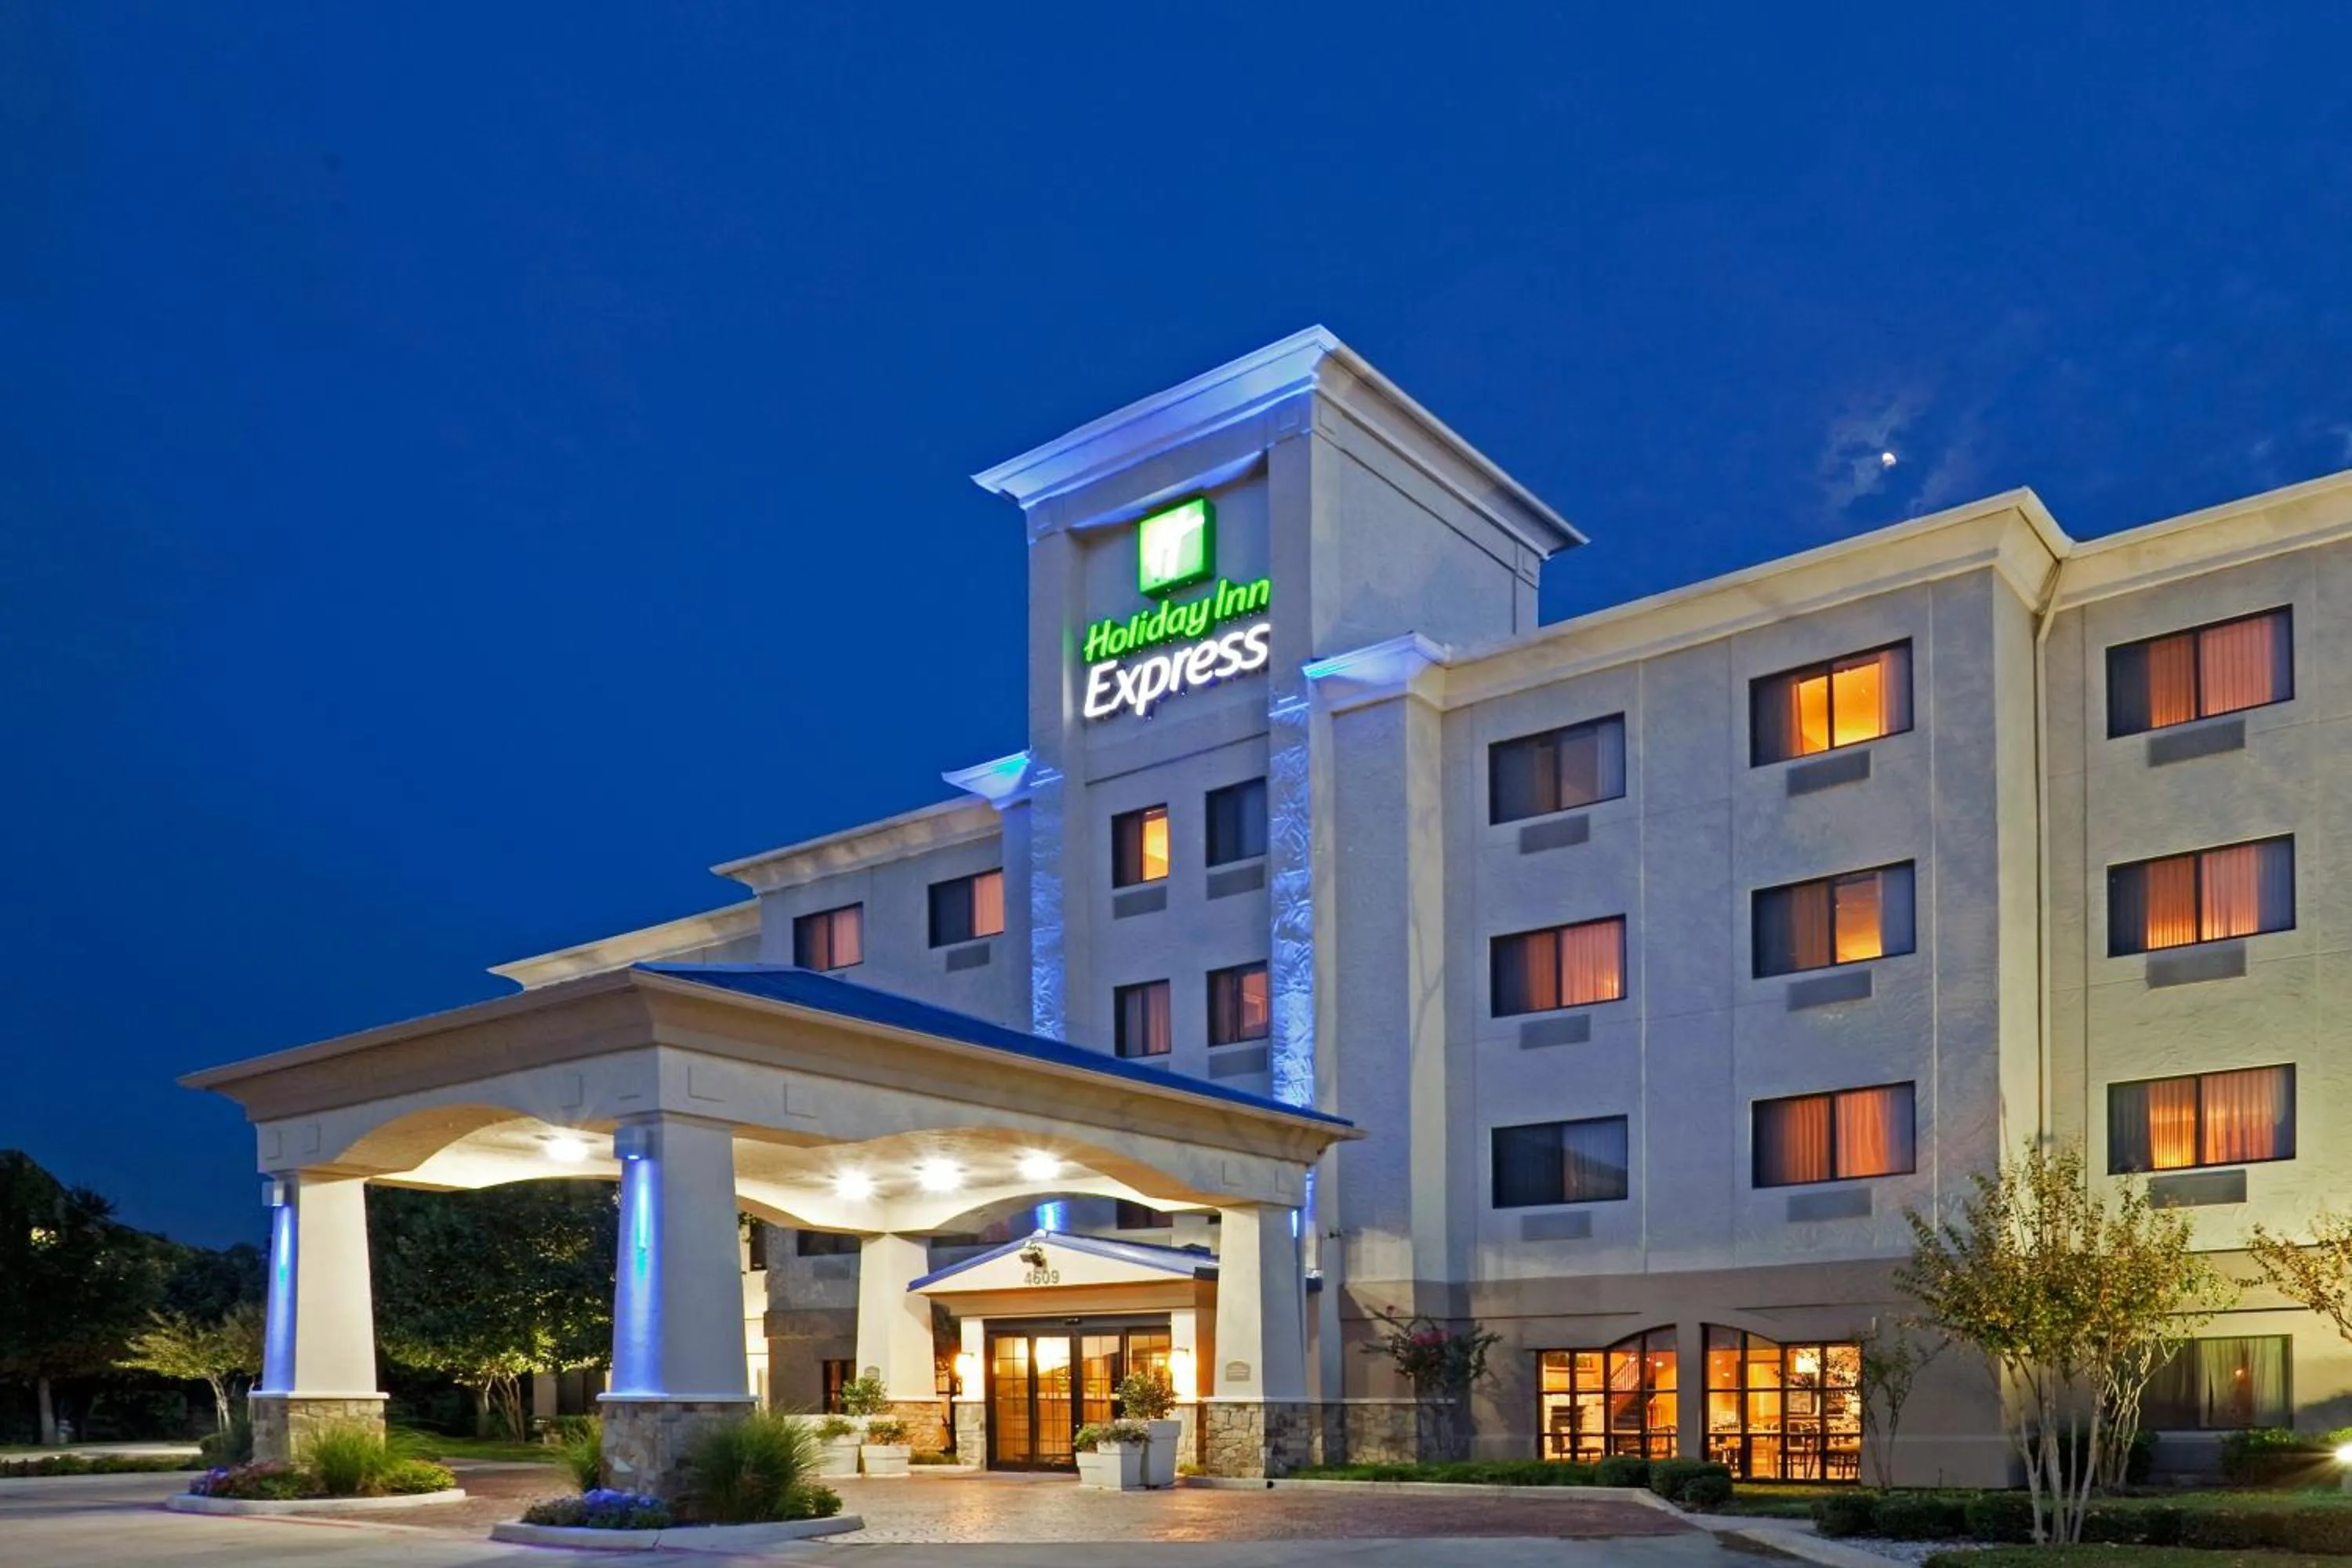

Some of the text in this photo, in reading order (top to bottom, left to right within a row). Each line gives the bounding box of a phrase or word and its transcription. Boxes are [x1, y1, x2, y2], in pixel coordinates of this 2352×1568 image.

[1083, 578, 1271, 662] Holiday Inn
[1083, 623, 1271, 719] Express
[1023, 1269, 1060, 1286] 4609
